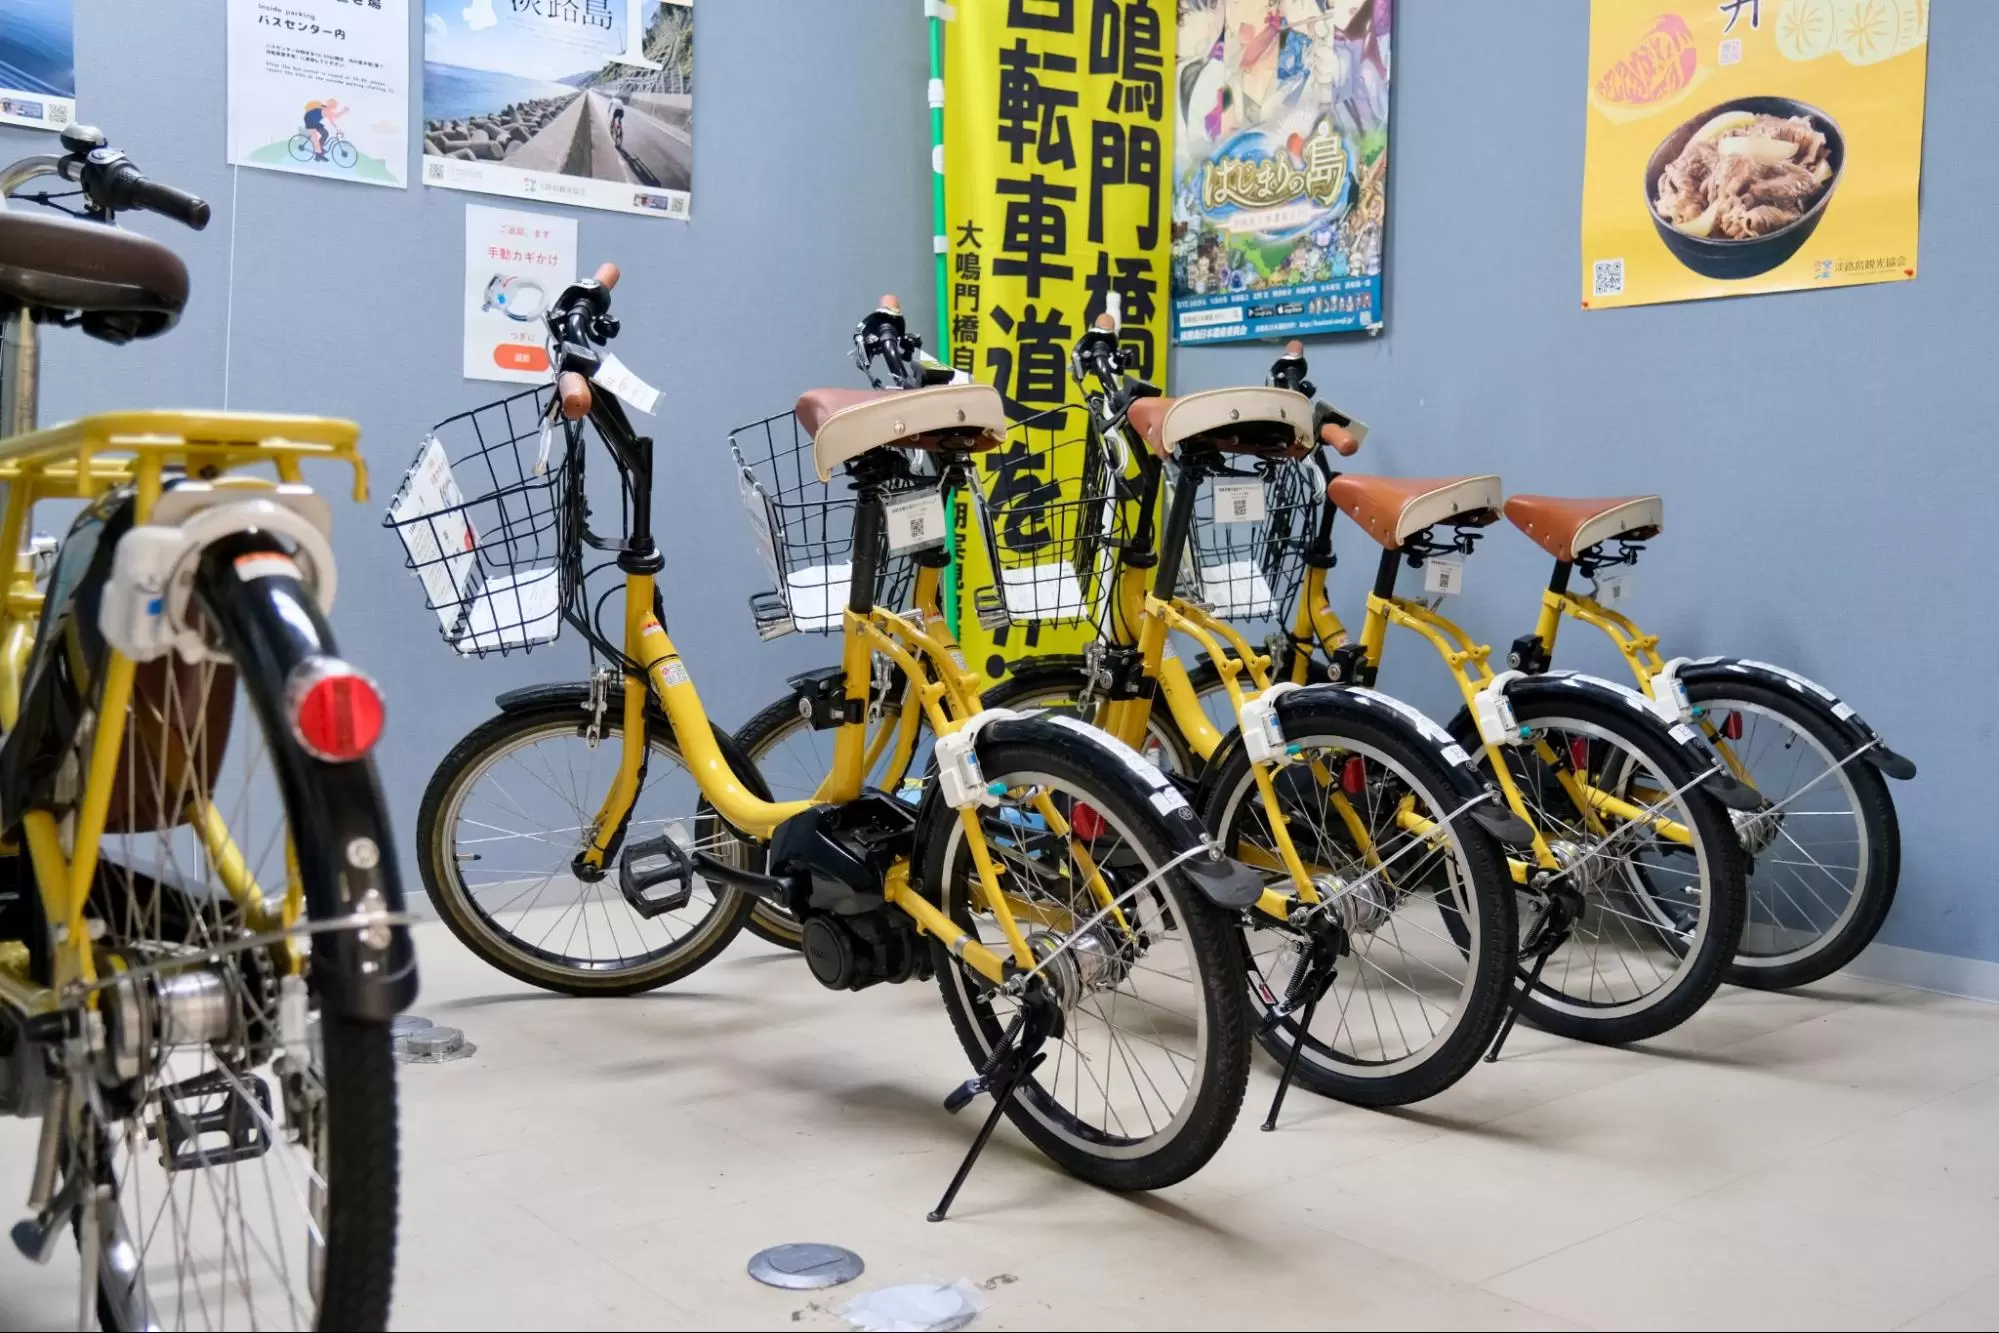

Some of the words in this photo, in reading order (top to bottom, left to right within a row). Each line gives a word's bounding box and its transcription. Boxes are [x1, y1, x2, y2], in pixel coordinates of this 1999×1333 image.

[258, 3, 282, 14] Inside
[286, 9, 316, 21] parking
[258, 15, 346, 40] バスセンター内
[1203, 121, 1346, 207] はじまりの島
[487, 246, 559, 267] 手動カギかけ
[1085, 0, 1164, 498] 鳴門橋
[510, 331, 535, 342] つぎに
